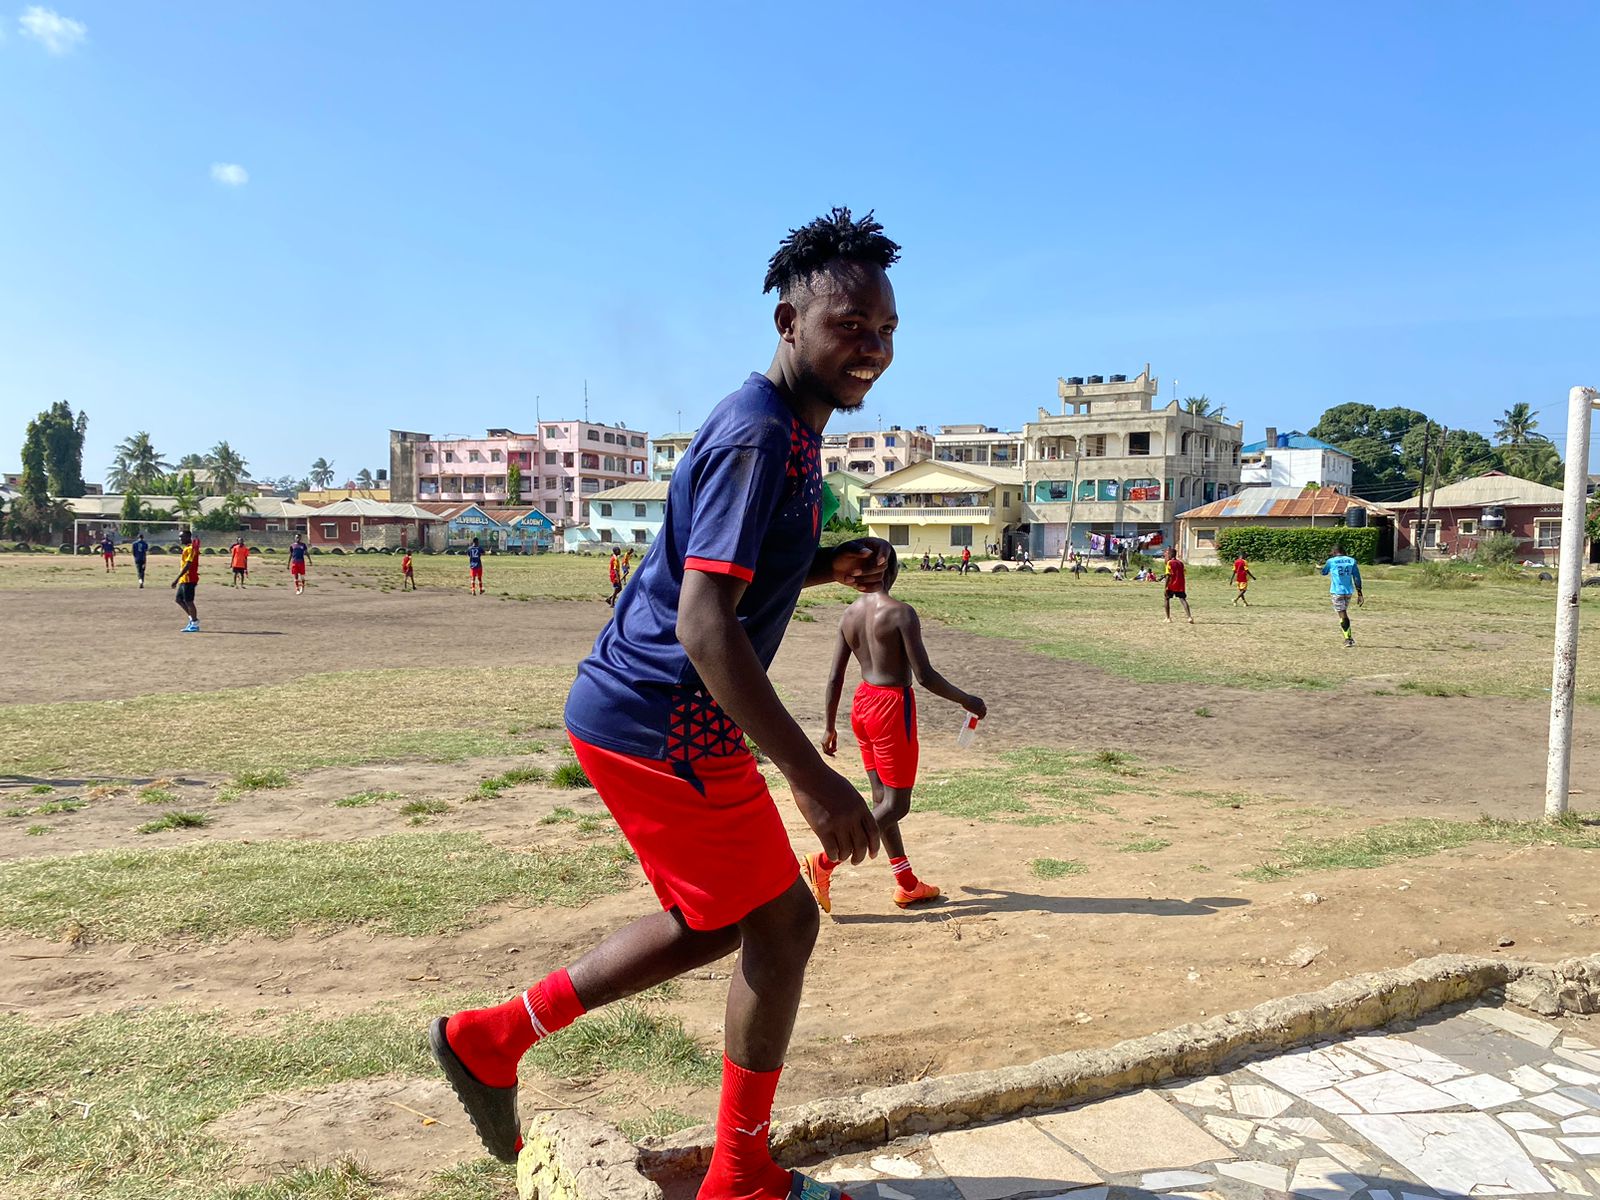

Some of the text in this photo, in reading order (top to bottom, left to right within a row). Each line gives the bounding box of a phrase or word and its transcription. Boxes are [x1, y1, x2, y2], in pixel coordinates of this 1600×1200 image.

[521, 518, 543, 526] ACADEMY
[471, 549, 479, 558] 12
[1337, 566, 1352, 575] 24
